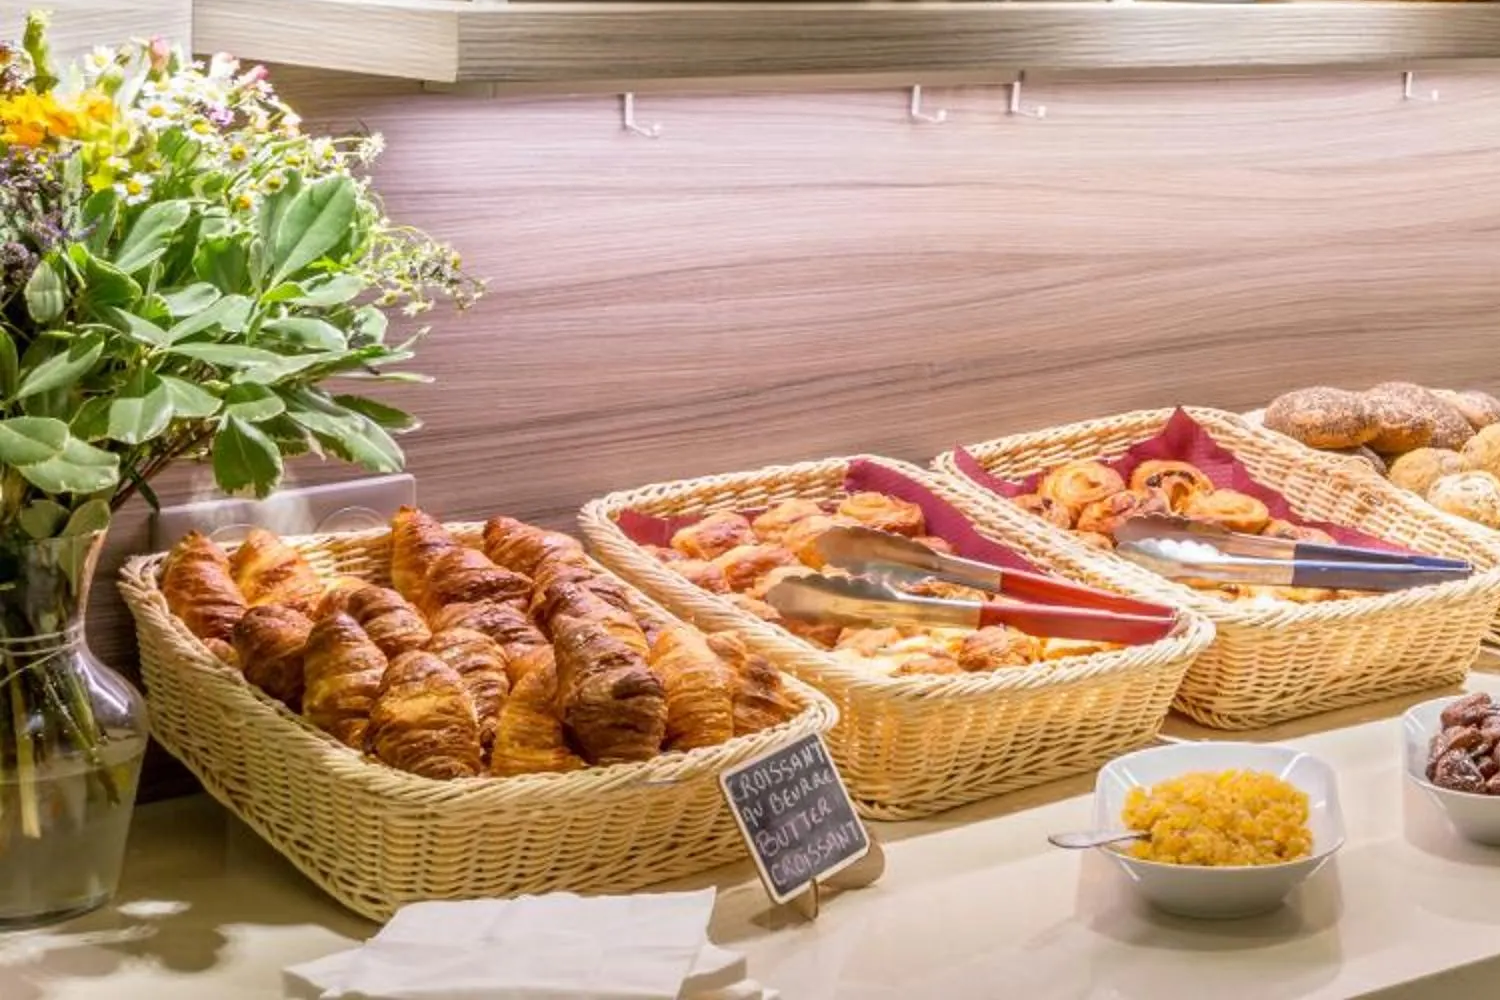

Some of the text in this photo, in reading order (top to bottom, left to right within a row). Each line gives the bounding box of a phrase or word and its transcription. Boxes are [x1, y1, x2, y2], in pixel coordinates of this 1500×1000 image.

[727, 741, 826, 802] CROISSANT
[754, 796, 833, 858] BUTTER
[769, 819, 860, 886] CROISSANT
